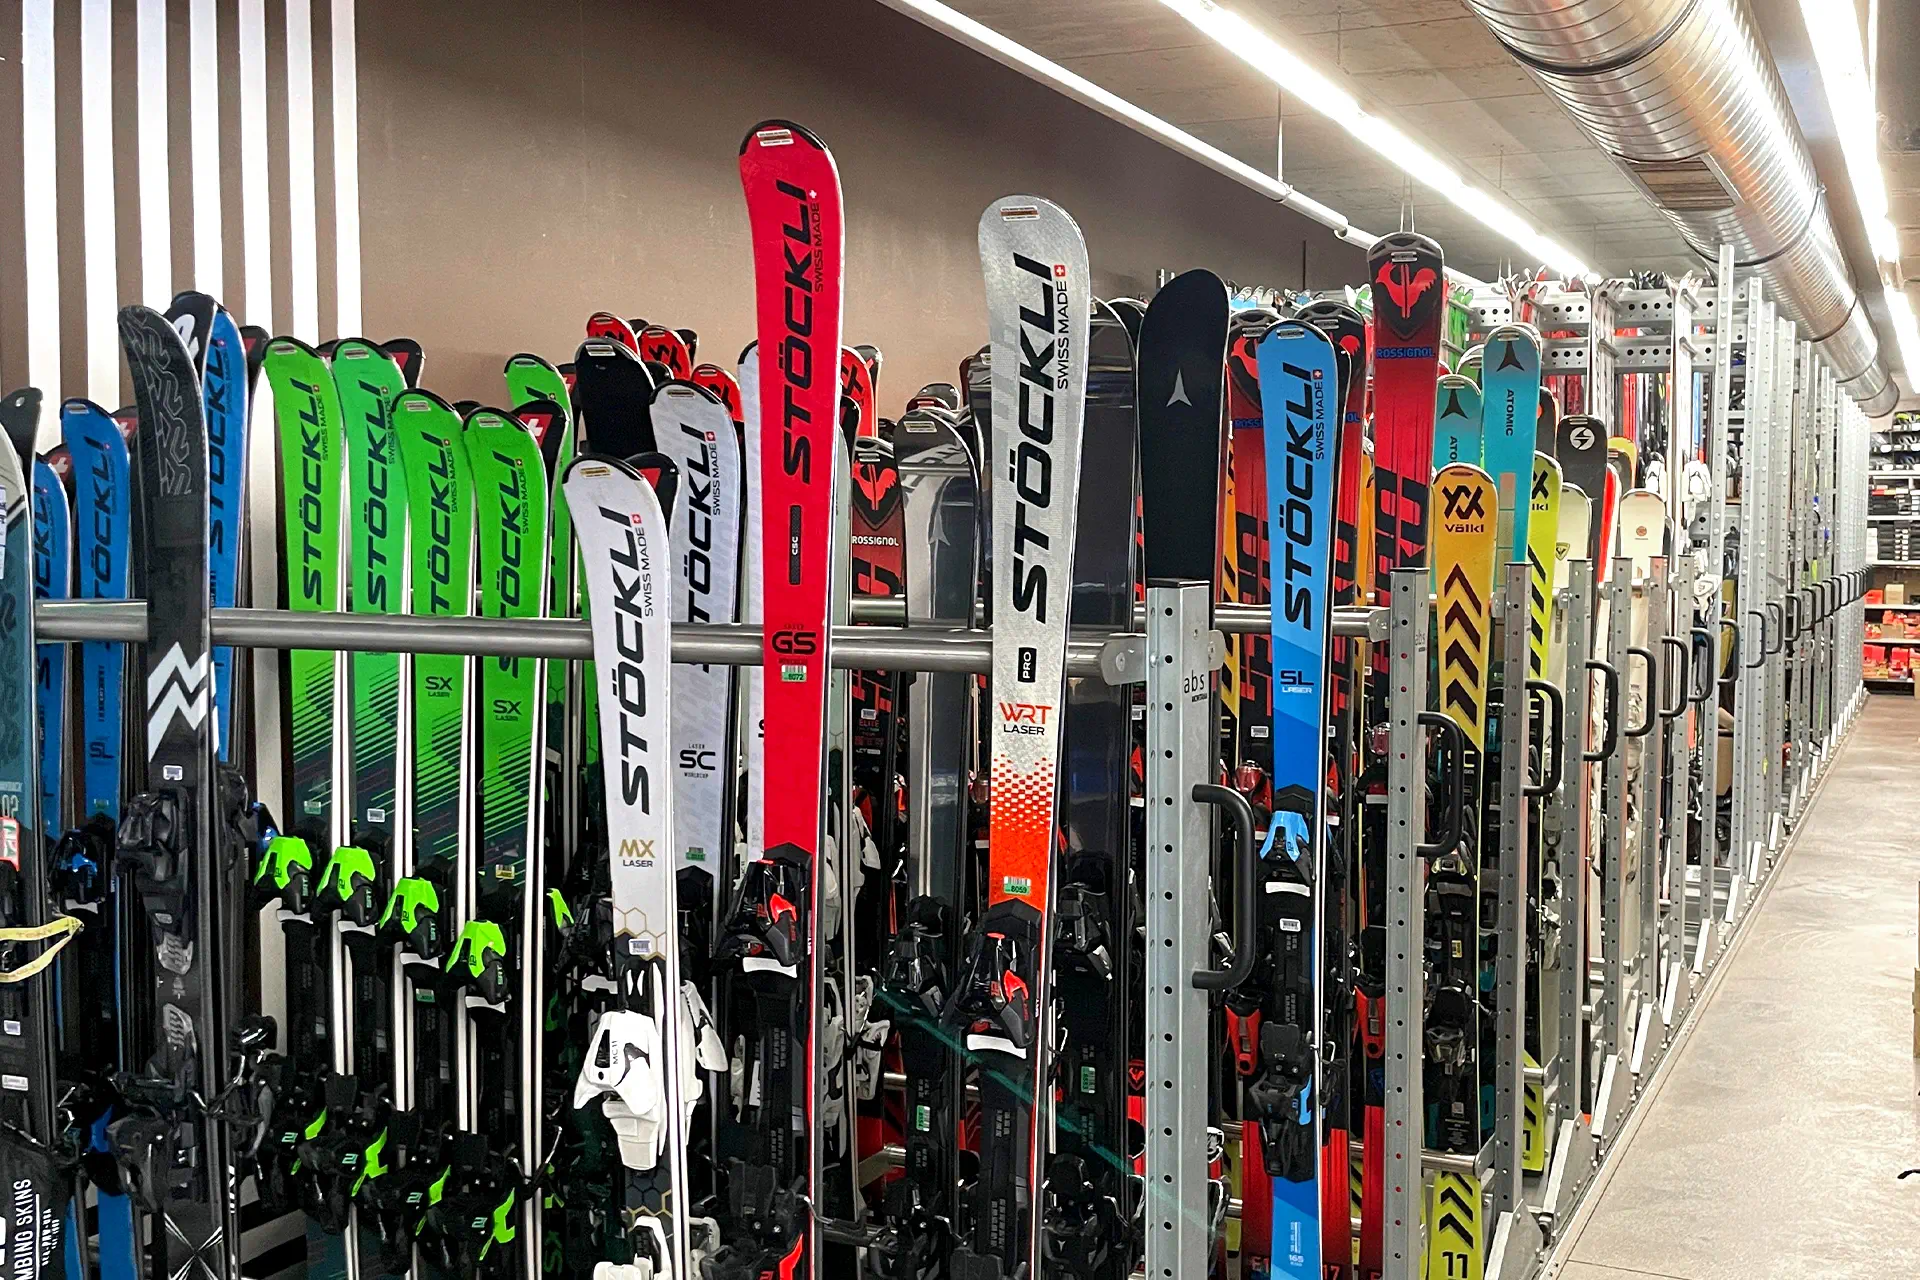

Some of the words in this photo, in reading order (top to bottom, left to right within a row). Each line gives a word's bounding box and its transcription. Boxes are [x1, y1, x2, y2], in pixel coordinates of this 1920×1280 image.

[810, 202, 822, 246] MADE
[814, 250, 824, 292] SWISS
[1056, 280, 1069, 334] MADE
[775, 179, 813, 485] STÖCKLI
[1057, 337, 1070, 389] SWISS
[1375, 347, 1435, 359] ROSSIGNOL
[317, 394, 327, 426] MADE
[1314, 381, 1324, 420] MADE
[1505, 388, 1514, 437] ATOMIC
[319, 427, 329, 462] SWISS
[1009, 251, 1055, 624] STÖCKLI
[1315, 422, 1324, 460] SWISS
[1449, 435, 1458, 463] ATO
[447, 449, 458, 480] MADE
[708, 442, 720, 478] MADE
[290, 377, 322, 606] STÖCKLI
[358, 379, 387, 612] STÖCKLI
[451, 481, 459, 514] SWISS
[519, 469, 529, 500] MADE
[713, 479, 721, 516] SWISS
[1279, 361, 1314, 631] STÖCKLI
[420, 431, 451, 614] TÖCKLI
[521, 501, 530, 535] SWISS
[1532, 503, 1549, 511] lkl
[852, 535, 899, 546] ROSSIGNOL
[1445, 523, 1485, 533] Völkl
[634, 525, 651, 571] MADE
[680, 422, 713, 674] TÖCKLI
[641, 572, 654, 617] SWISS
[772, 631, 817, 656] GS
[597, 504, 650, 816] STÖCKLI
[1022, 651, 1032, 679] PRO
[425, 676, 453, 691] SX
[1184, 669, 1205, 694] abs
[1280, 670, 1314, 686] SL
[1282, 685, 1312, 694] LASER
[493, 700, 522, 715] SX
[999, 702, 1052, 725] WRT
[1003, 724, 1045, 736] LASER
[679, 749, 716, 771] SC
[619, 839, 655, 859] MX
[623, 859, 653, 868] LASER
[611, 1040, 619, 1048] 11
[611, 1050, 619, 1065] MC
[13, 1178, 33, 1226] SKINS
[1441, 1251, 1468, 1279] 11
